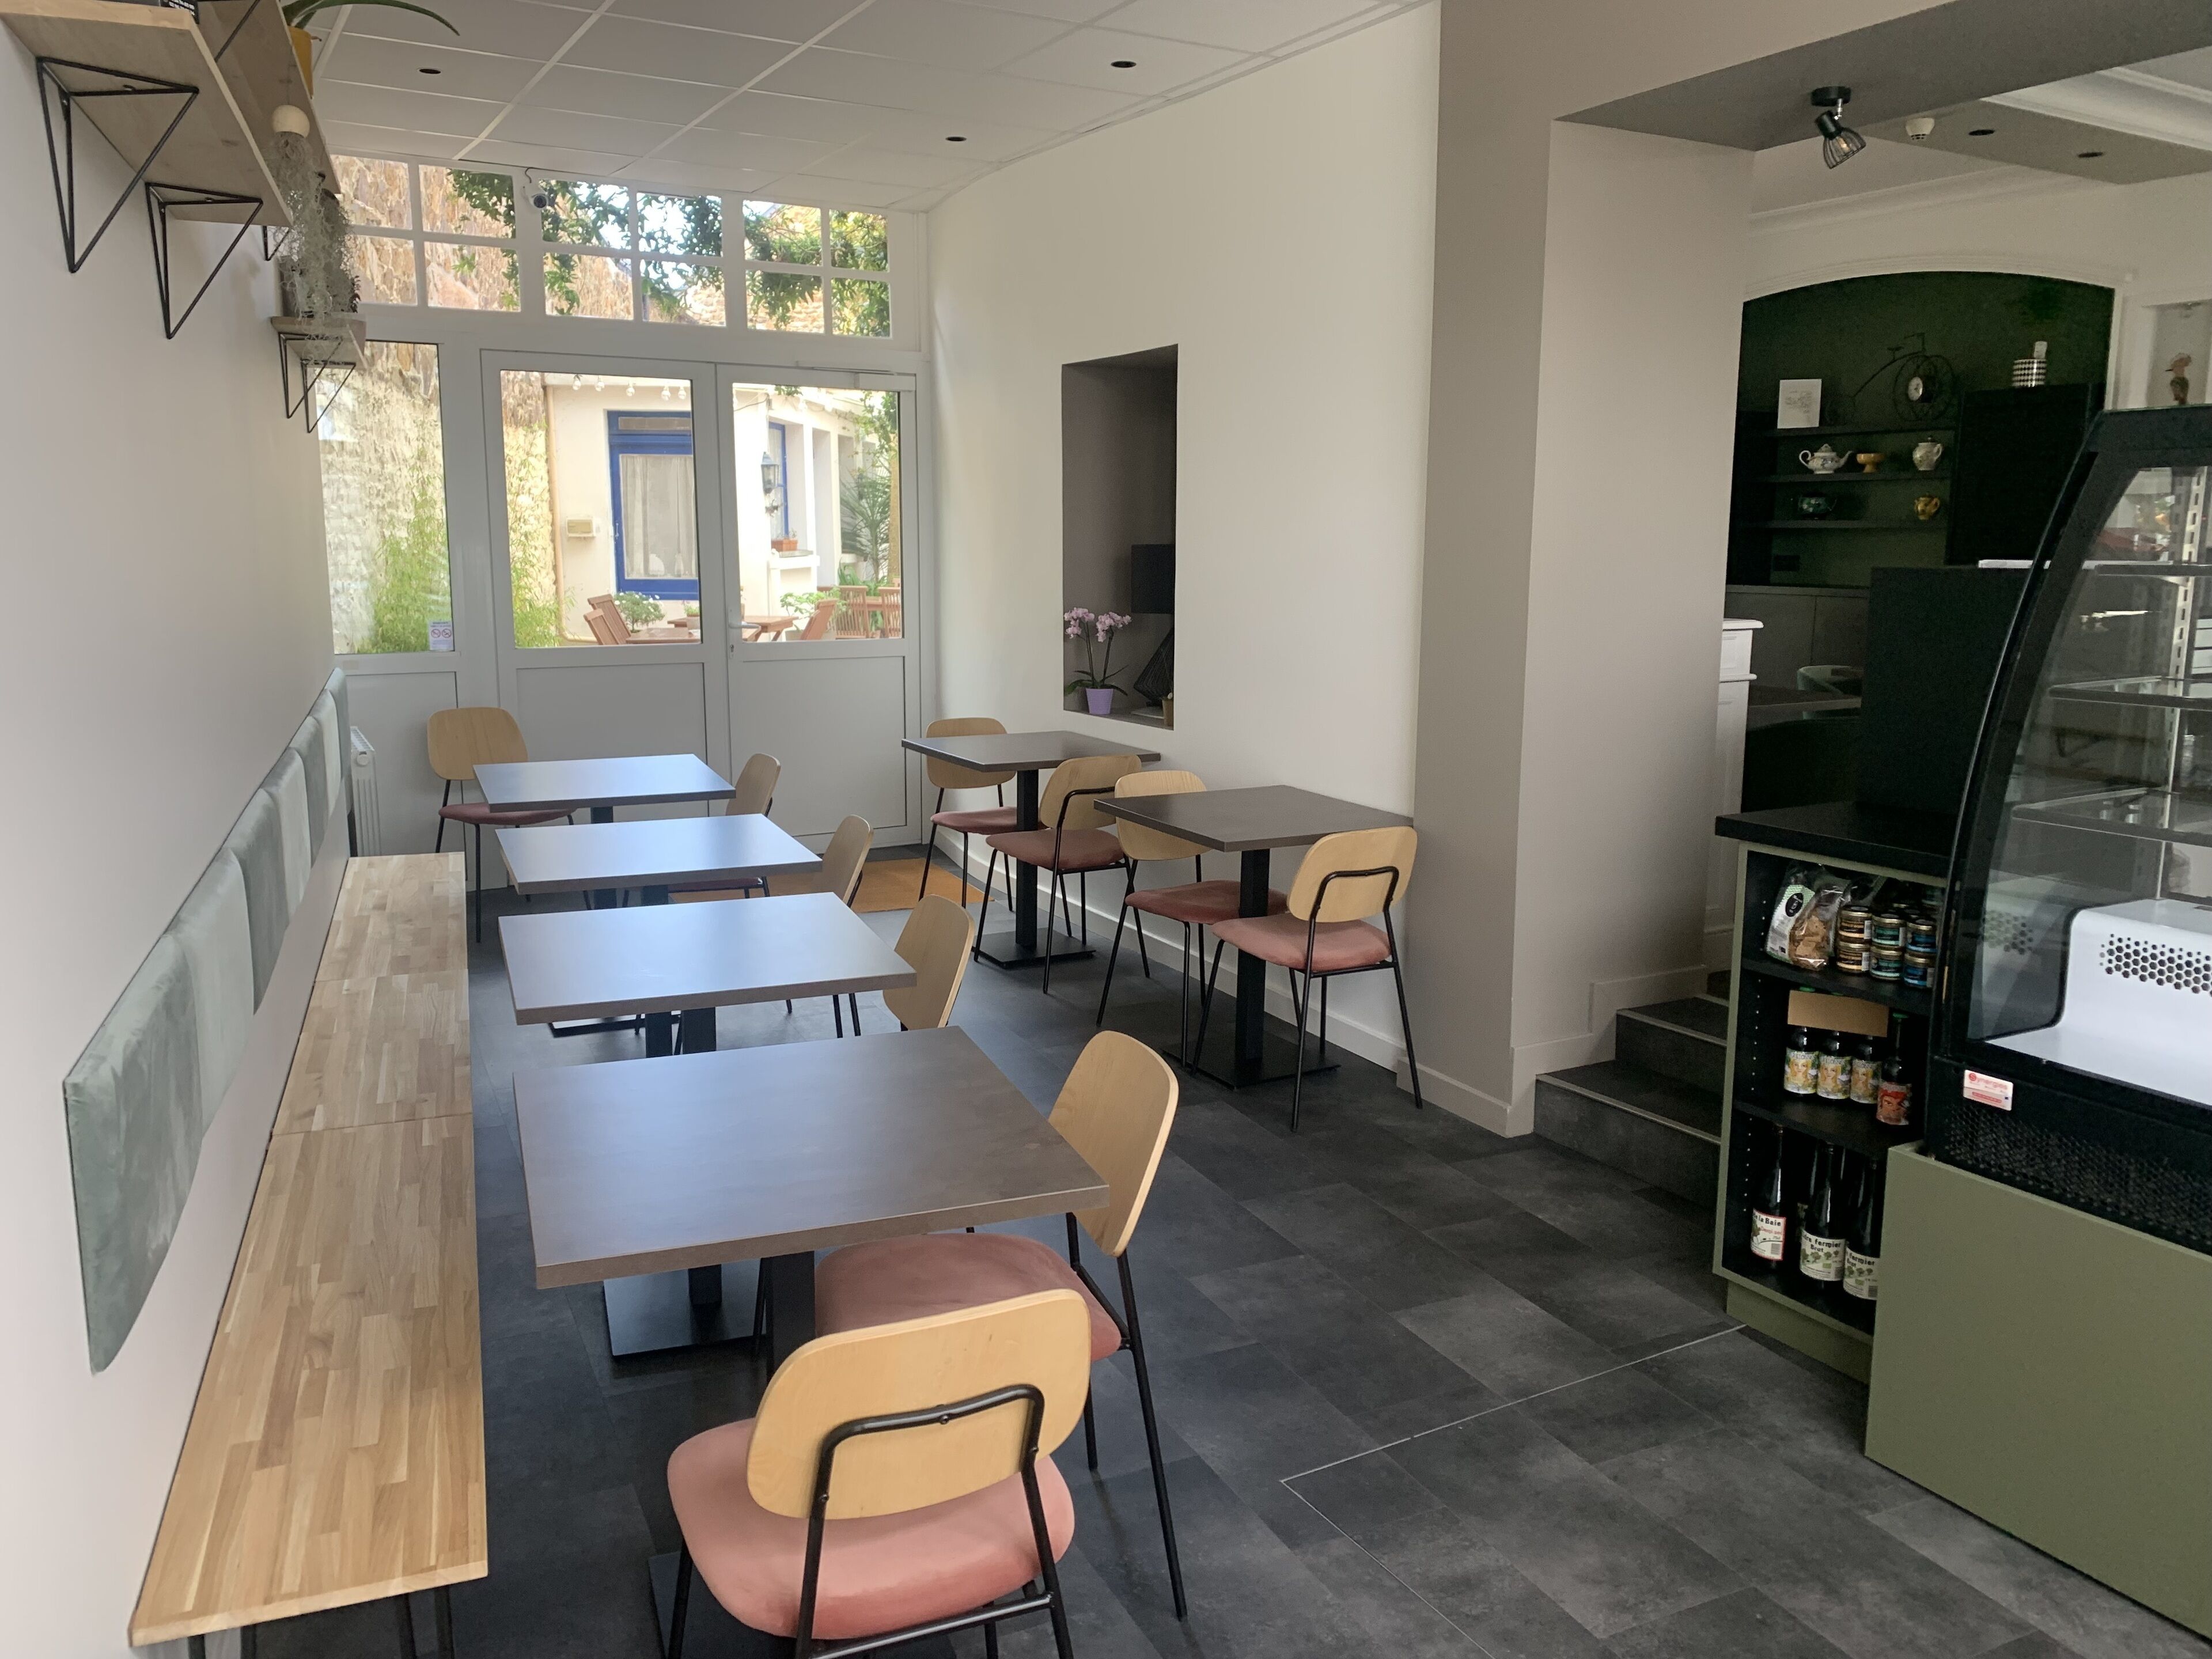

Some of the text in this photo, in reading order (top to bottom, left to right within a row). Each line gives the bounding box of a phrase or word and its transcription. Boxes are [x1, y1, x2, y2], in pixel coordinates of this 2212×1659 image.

[1765, 1218, 1781, 1226] Baie
[1815, 1238, 1841, 1248] fermier
[1810, 1244, 1824, 1253] Brut
